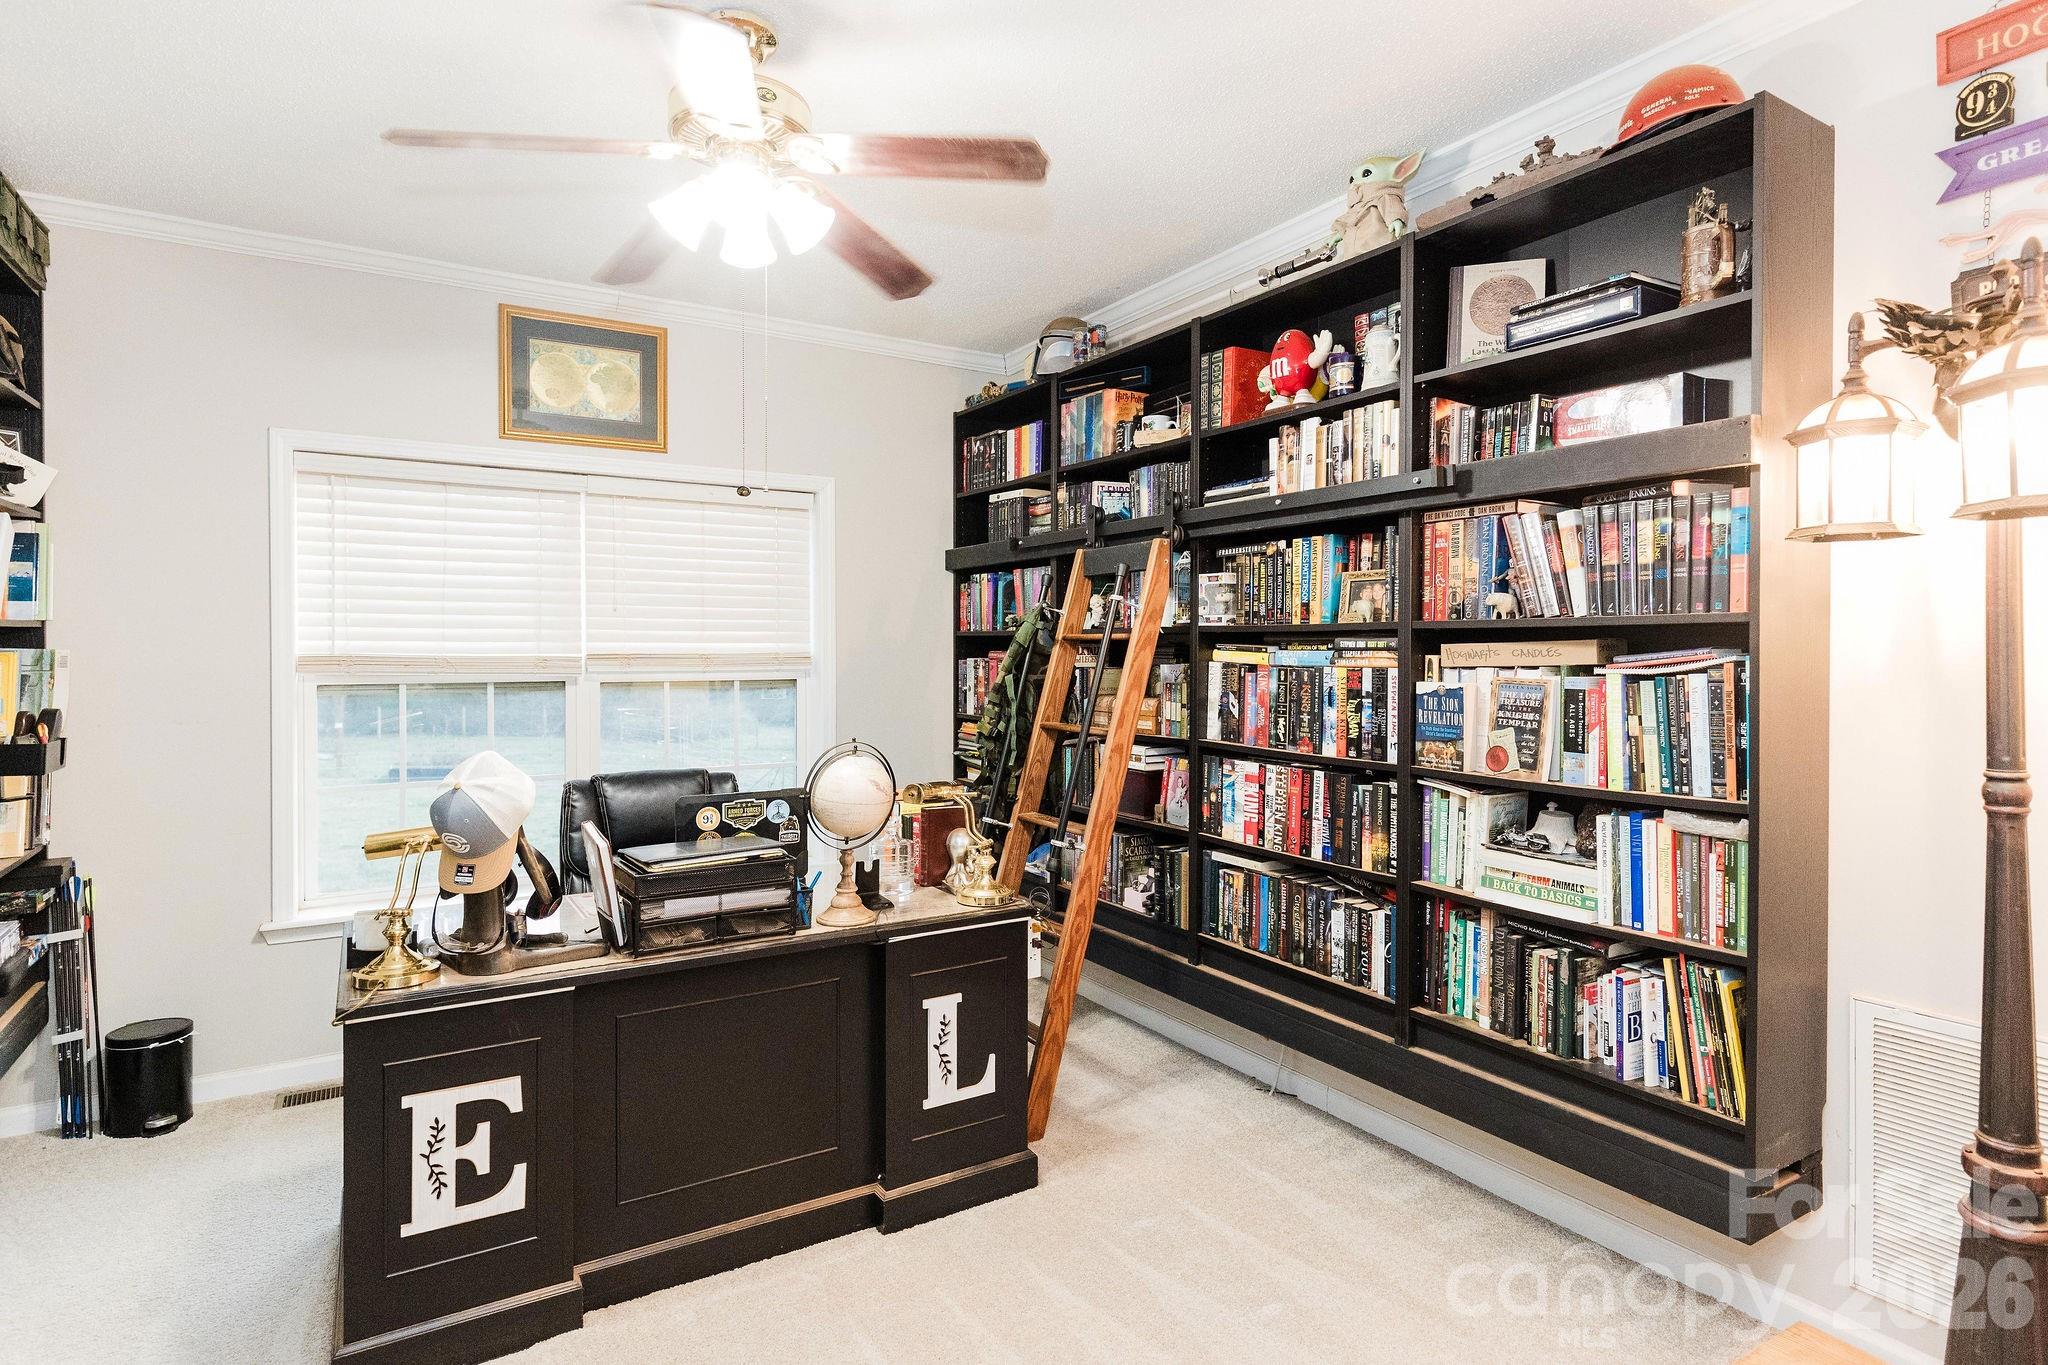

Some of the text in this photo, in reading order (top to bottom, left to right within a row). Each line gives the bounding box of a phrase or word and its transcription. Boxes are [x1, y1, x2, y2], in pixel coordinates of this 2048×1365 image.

[1641, 96, 1673, 115] GENERAL
[1476, 340, 1494, 348] The
[1426, 504, 1506, 521] THE VINCI CODE DAN BROWN
[1451, 524, 1460, 558] DAN BROWN
[1586, 524, 1594, 565] ARMAGEDDON
[1623, 522, 1631, 564] DESECRATION
[1511, 646, 1563, 659] CANDLES
[1301, 684, 1310, 711] KING
[1423, 696, 1459, 711] THE SION
[1500, 699, 1541, 708] TREASURE
[1501, 691, 1542, 700] THE LOST
[1418, 709, 1464, 727] REVELATION
[1497, 711, 1540, 721] KNIGHTS
[1498, 718, 1539, 729] TEMPLAR
[744, 806, 762, 814] FORCES
[1244, 790, 1258, 822] KING
[1274, 766, 1284, 851] STEPHEN KING
[1322, 819, 1330, 847] REVIVAL
[1631, 819, 1641, 830] SIX
[1493, 877, 1582, 907] BACK TO BASICS
[1525, 873, 1585, 894] FARM ANIMALS
[1507, 920, 1528, 931] MICHIO
[1528, 926, 1544, 937] KAKU
[1495, 931, 1504, 988] DAN BROWN
[922, 992, 997, 1110] L
[400, 1075, 527, 1238] E
